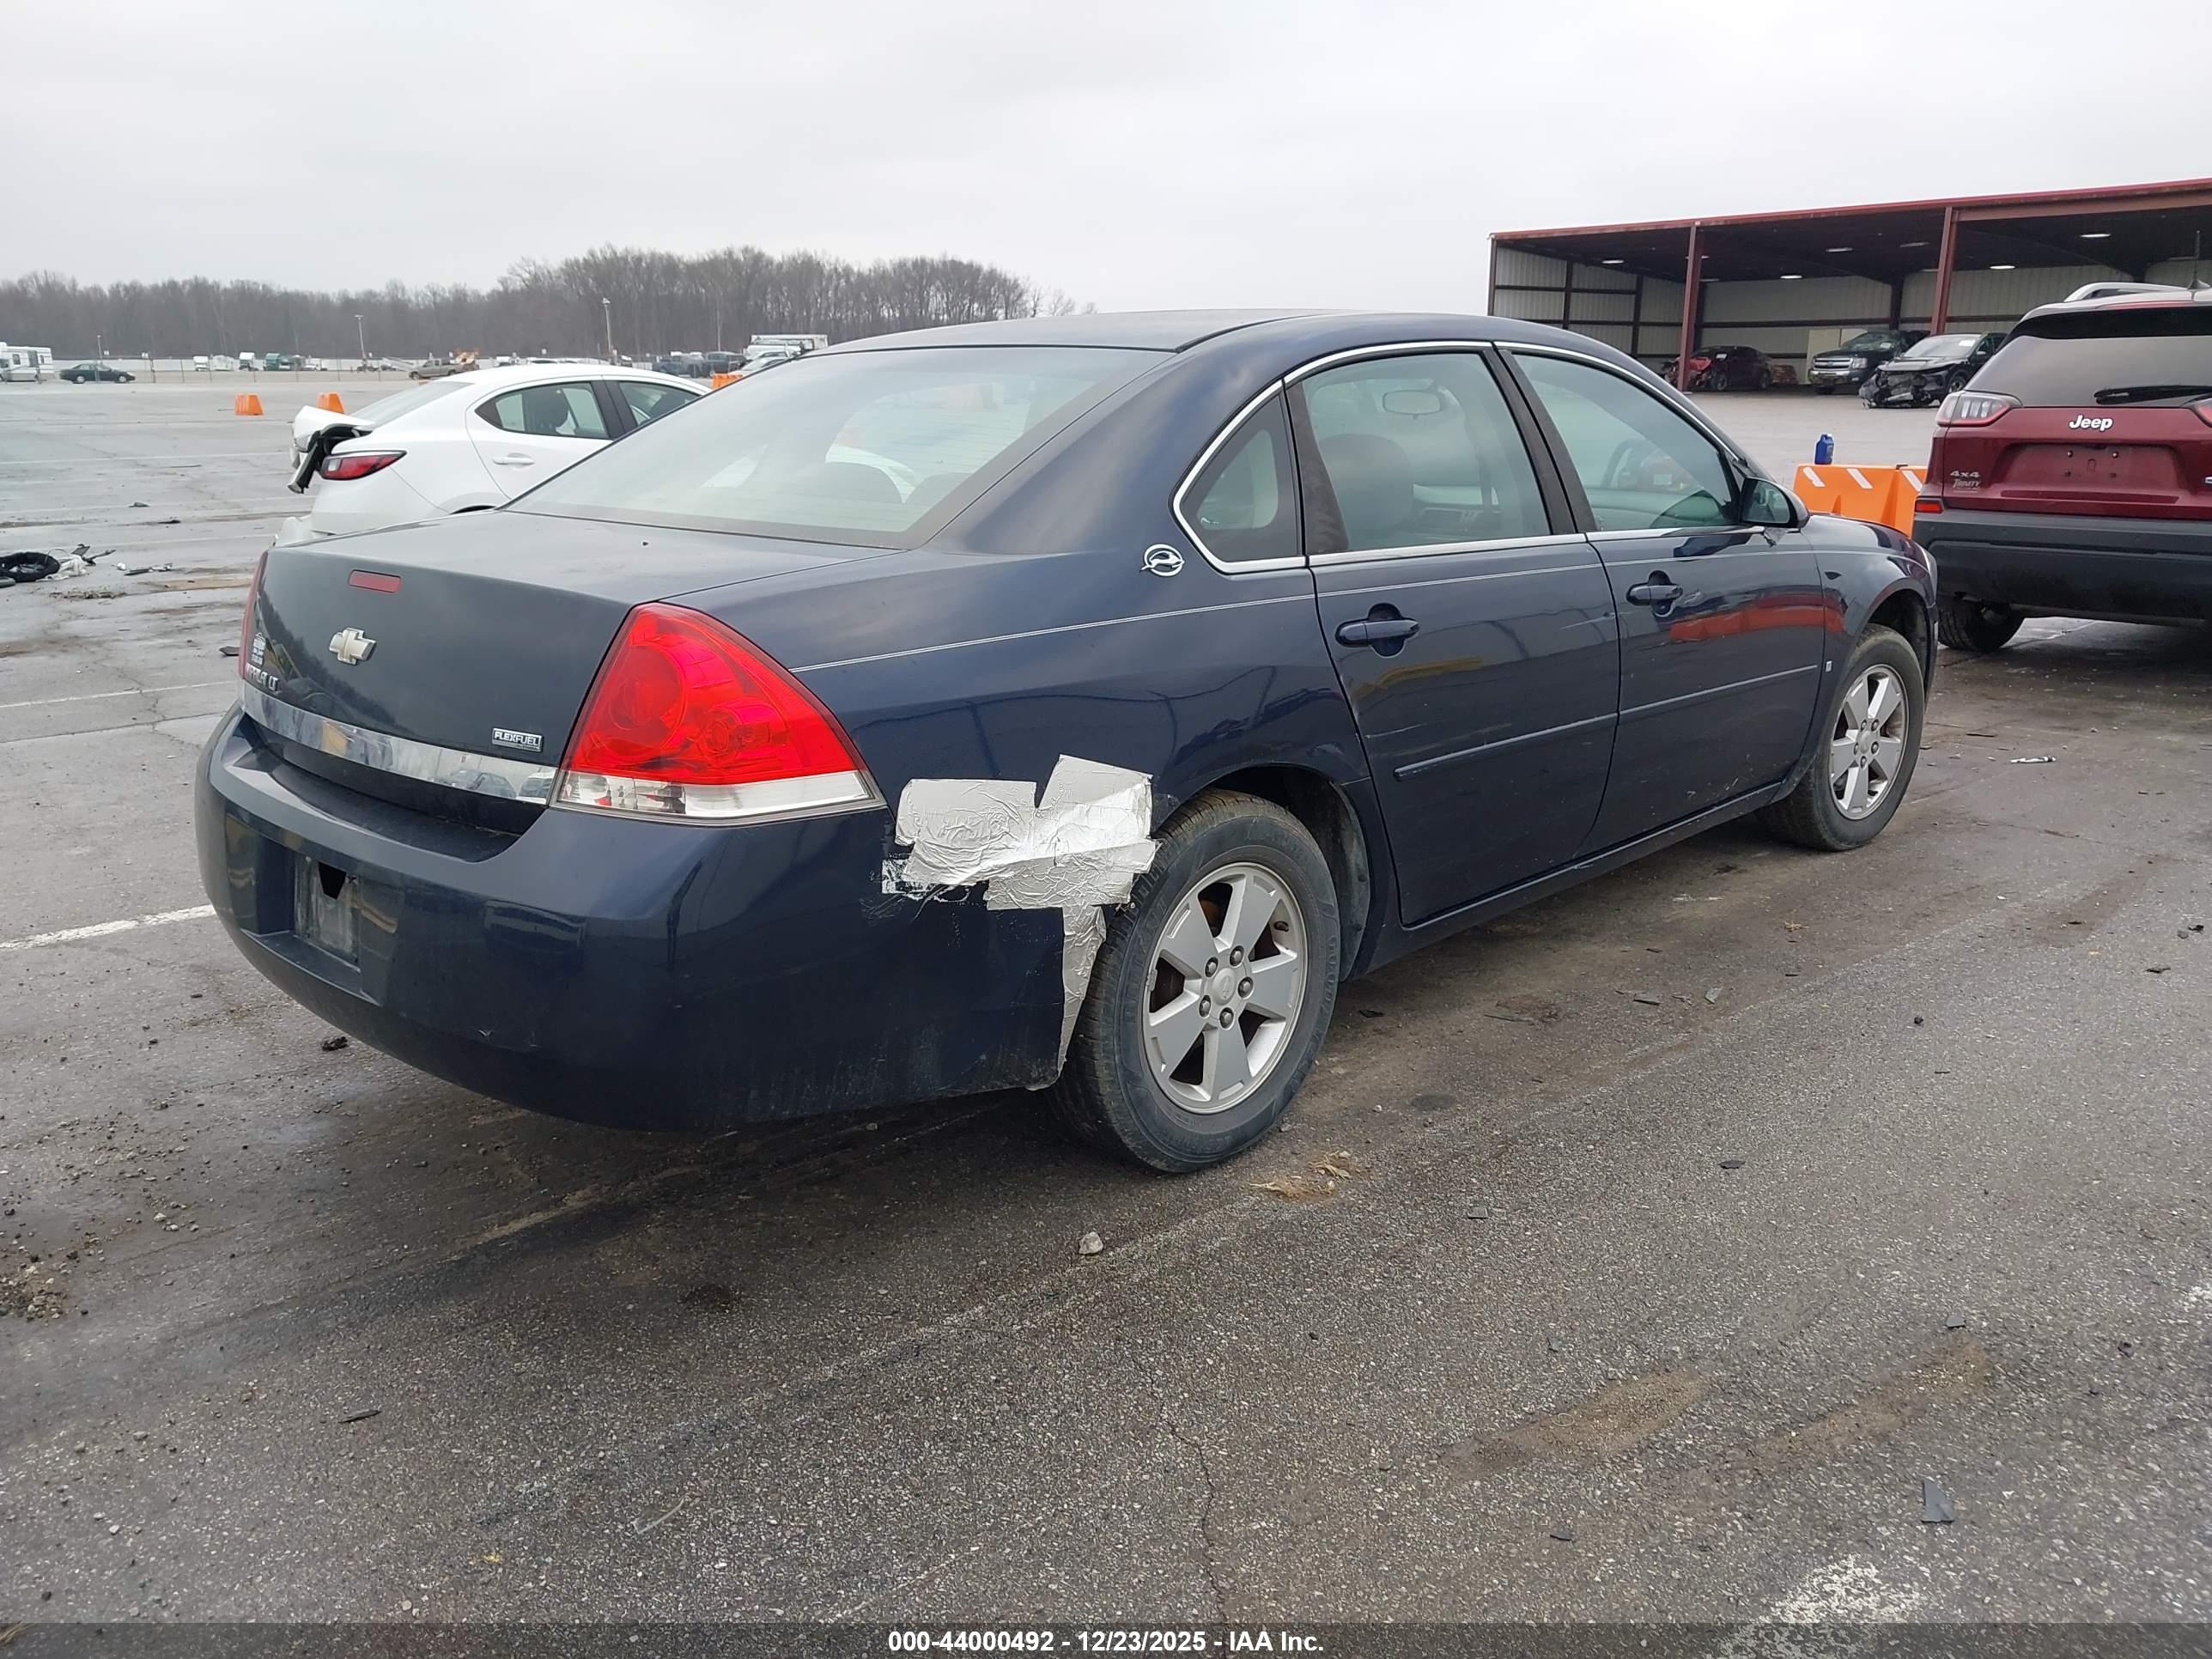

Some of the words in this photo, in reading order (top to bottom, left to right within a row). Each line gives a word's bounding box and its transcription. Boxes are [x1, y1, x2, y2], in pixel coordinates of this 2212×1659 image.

[2069, 414, 2114, 432] Jeep
[1949, 470, 1981, 478] 4x4
[494, 731, 538, 747] FLEXFUEL
